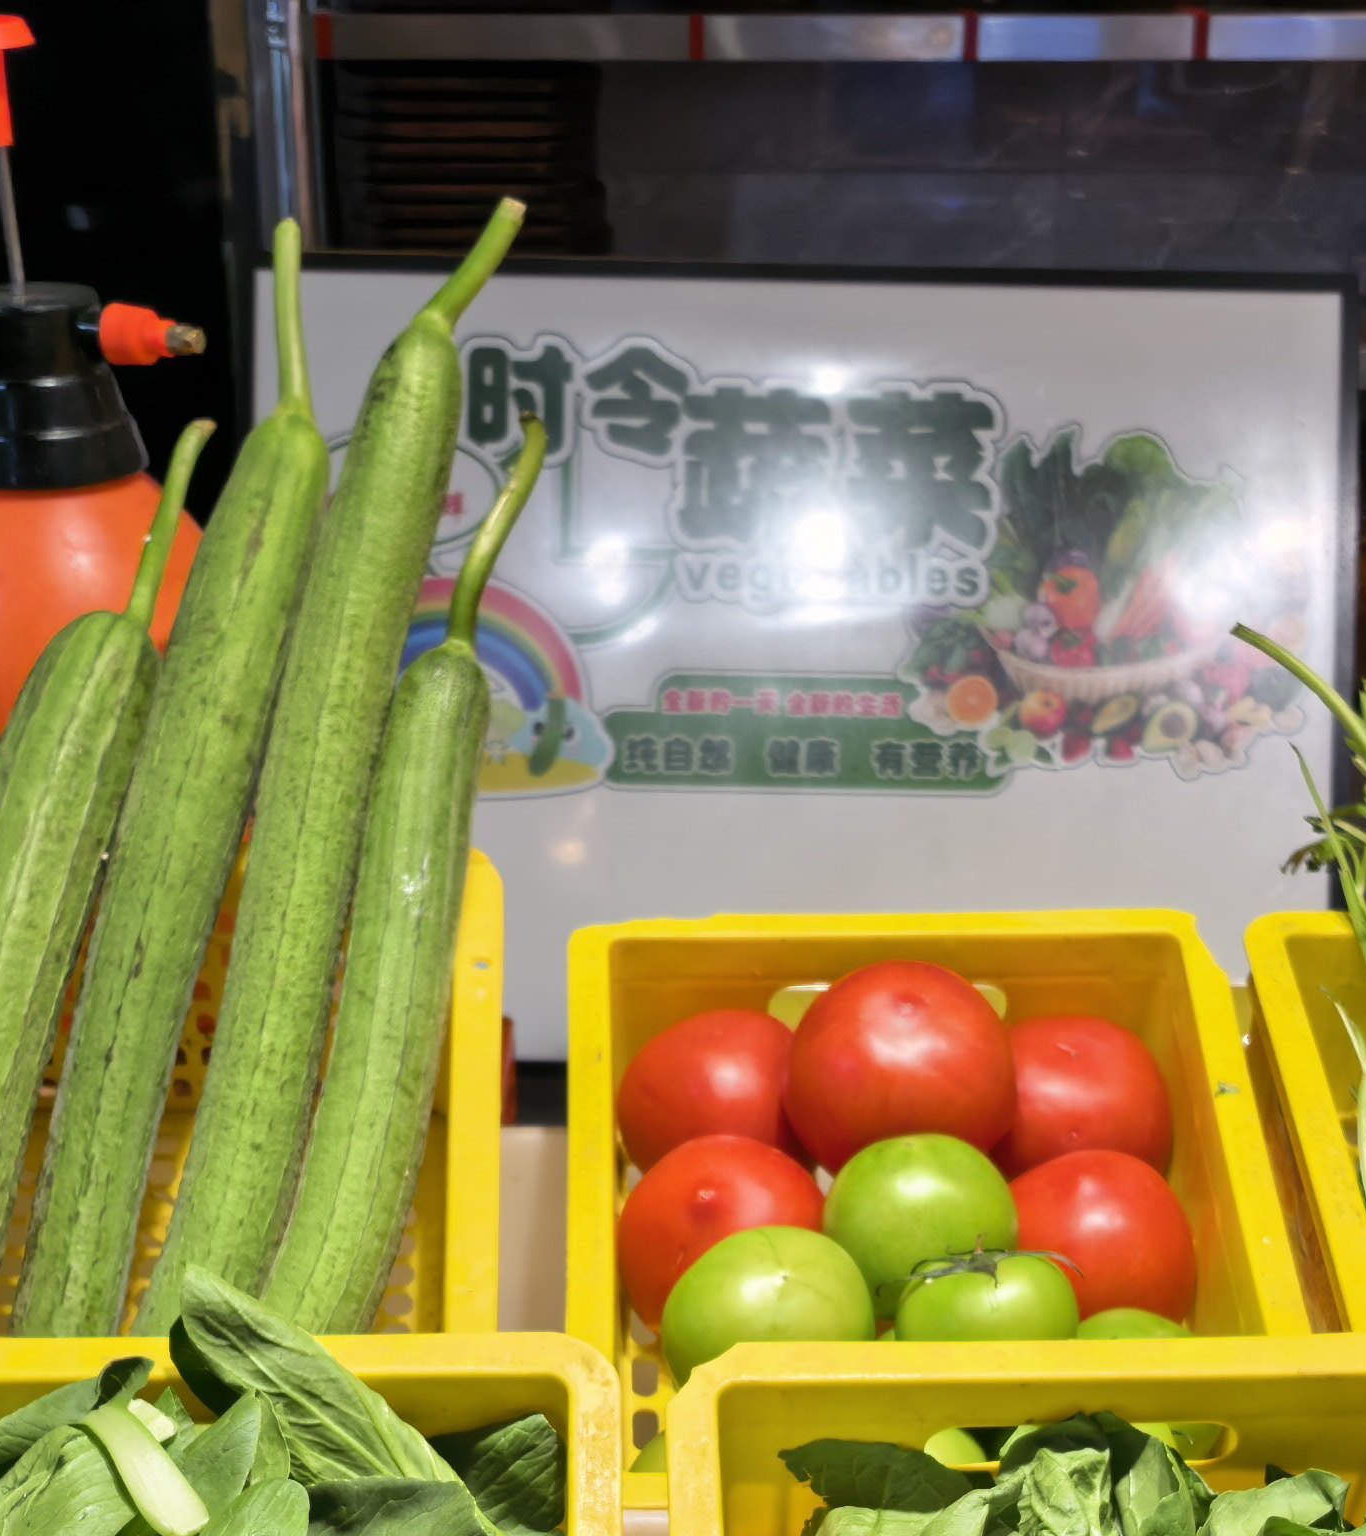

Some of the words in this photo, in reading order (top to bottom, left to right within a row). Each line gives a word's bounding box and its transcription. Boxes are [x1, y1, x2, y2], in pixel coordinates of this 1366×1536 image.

[467, 344, 995, 553] 时令蔬菜
[685, 552, 982, 604] vegables
